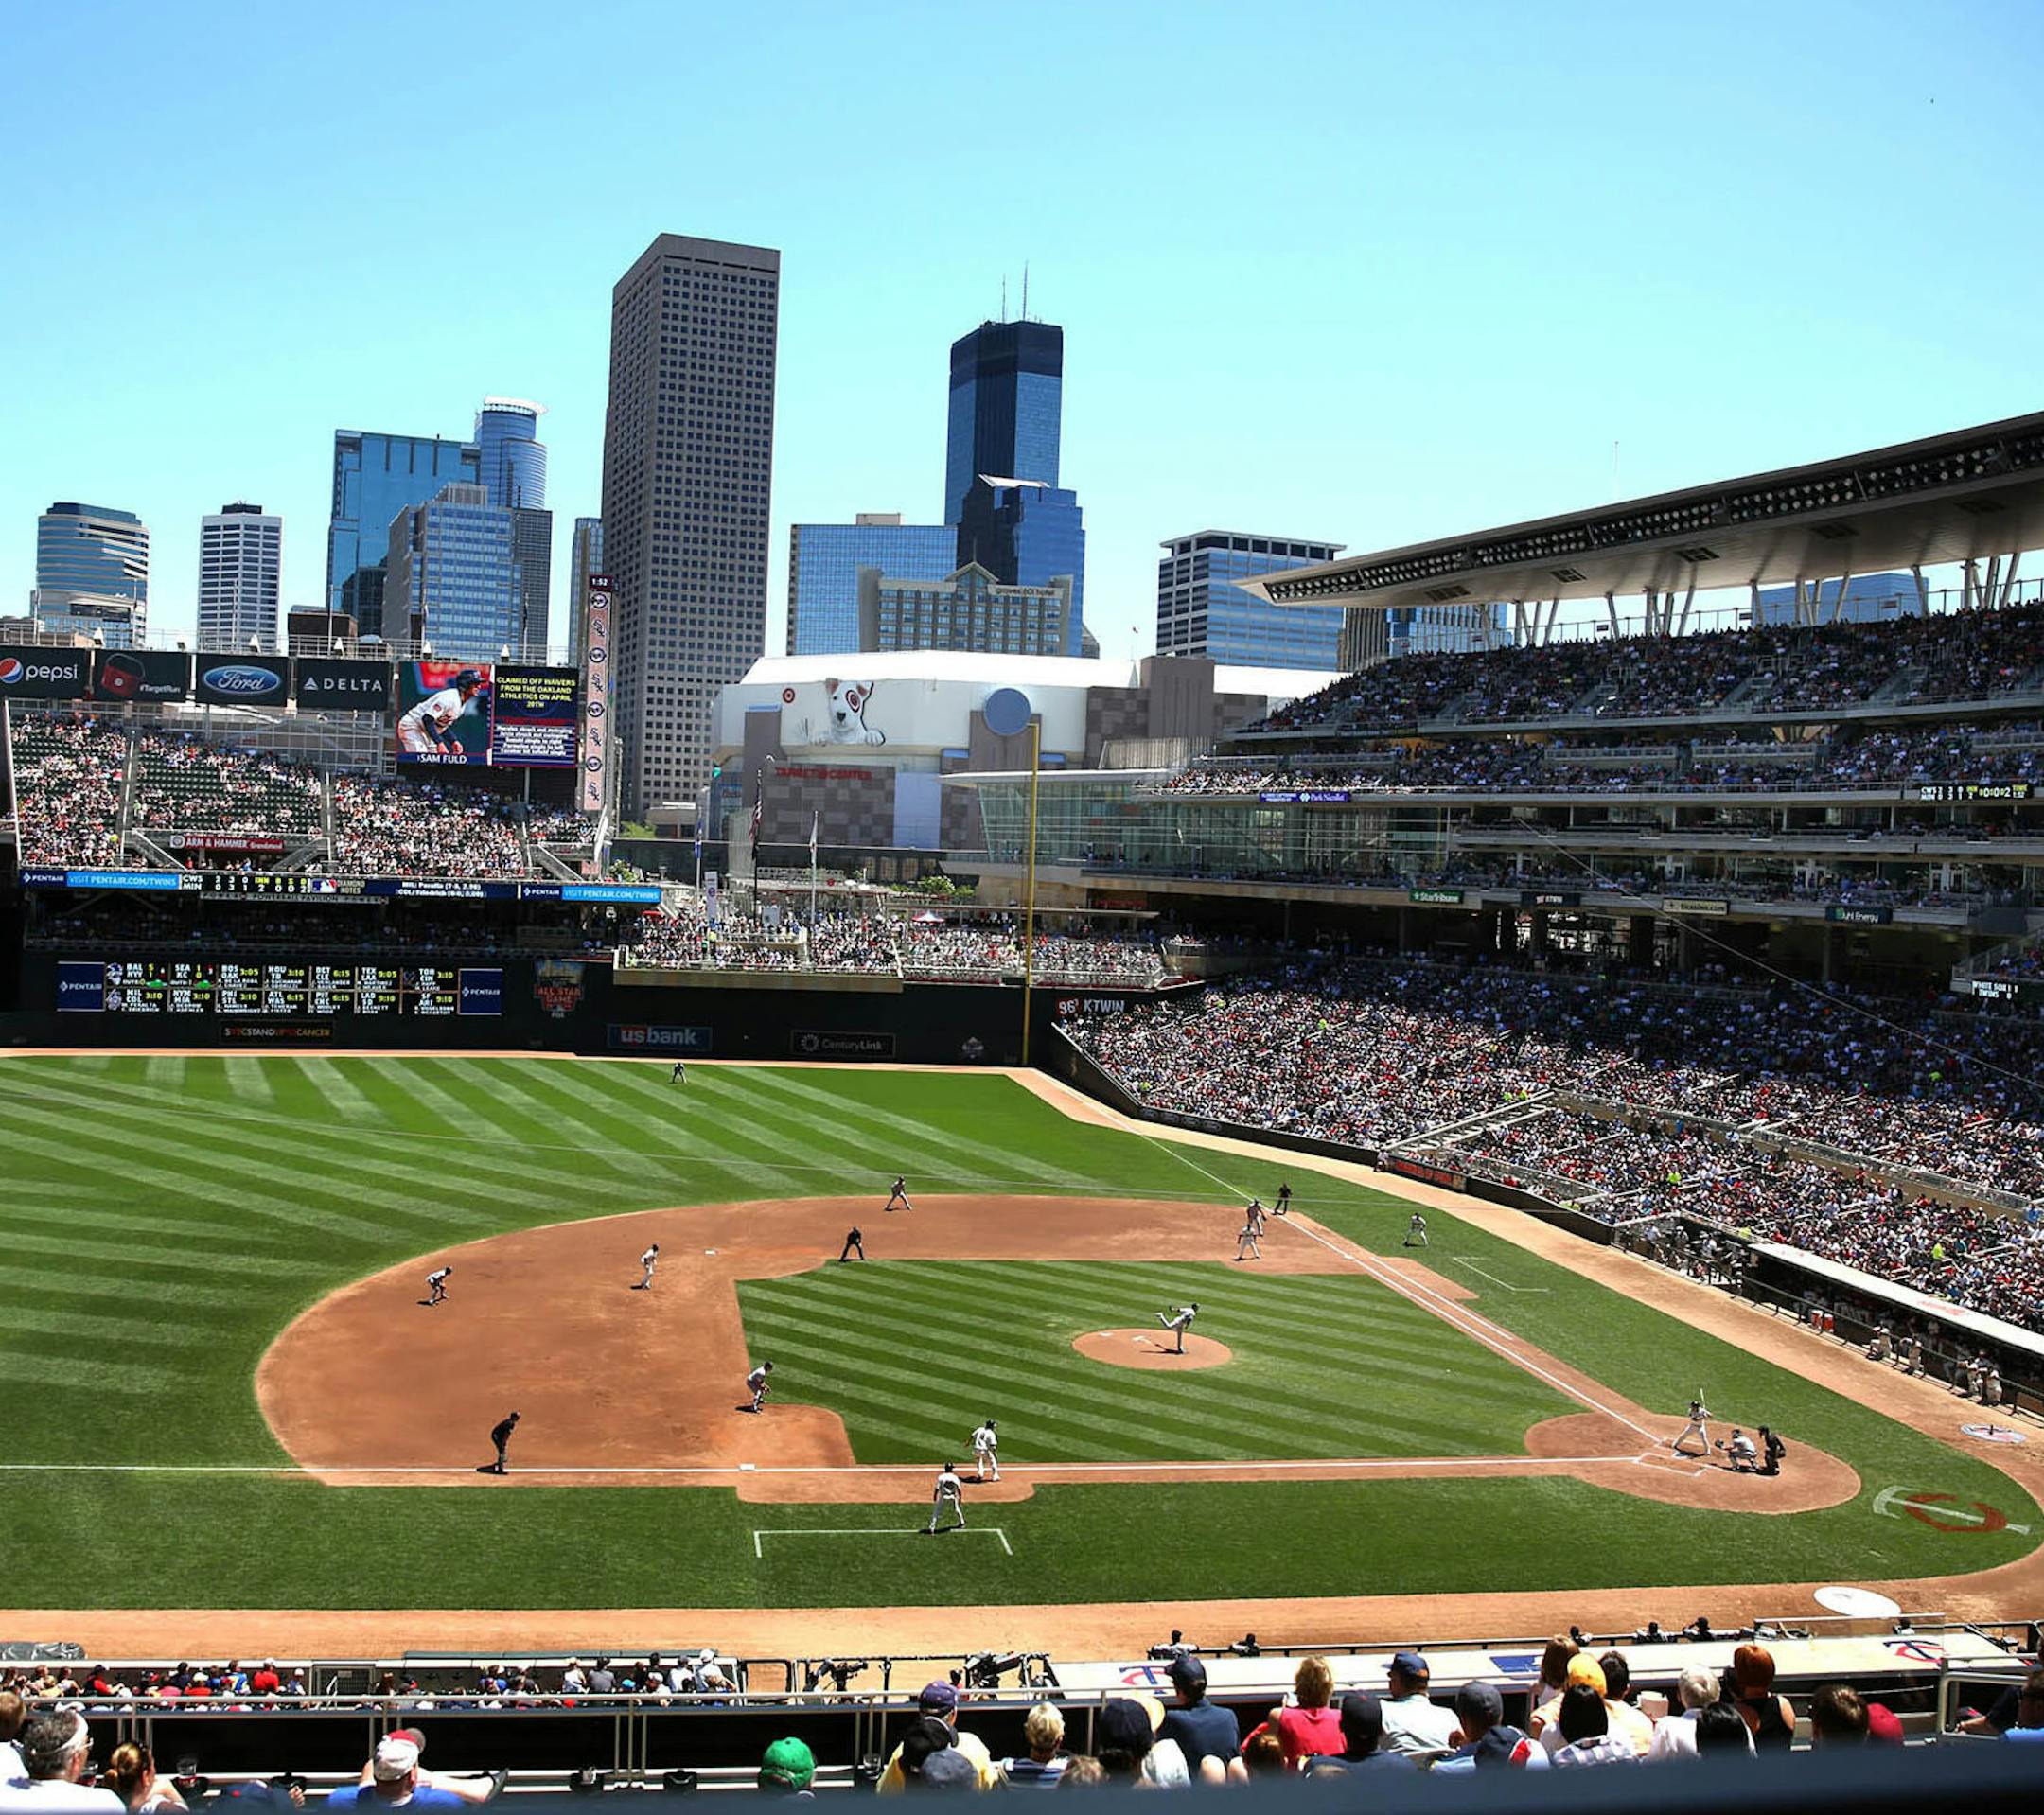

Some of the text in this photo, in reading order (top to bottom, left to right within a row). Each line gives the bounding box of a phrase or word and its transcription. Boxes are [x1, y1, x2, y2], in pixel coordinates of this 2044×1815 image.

[26, 664, 78, 683] pepsi
[217, 670, 265, 692] Ford
[323, 677, 383, 692] DELTA
[544, 678, 576, 687] WAIVERS
[139, 684, 181, 694] #TargetRun
[420, 755, 467, 764] SAM FULD
[186, 838, 204, 847] ARM
[206, 839, 212, 847] &
[213, 839, 248, 848] HAMMER
[91, 876, 176, 886] PENTAIR.COM/TWINS
[583, 890, 659, 899] PENTAIR.COM/TWINS
[1855, 911, 1879, 923] Energy
[1084, 999, 1125, 1012] KTWIN
[822, 1038, 882, 1051] CenturyLink
